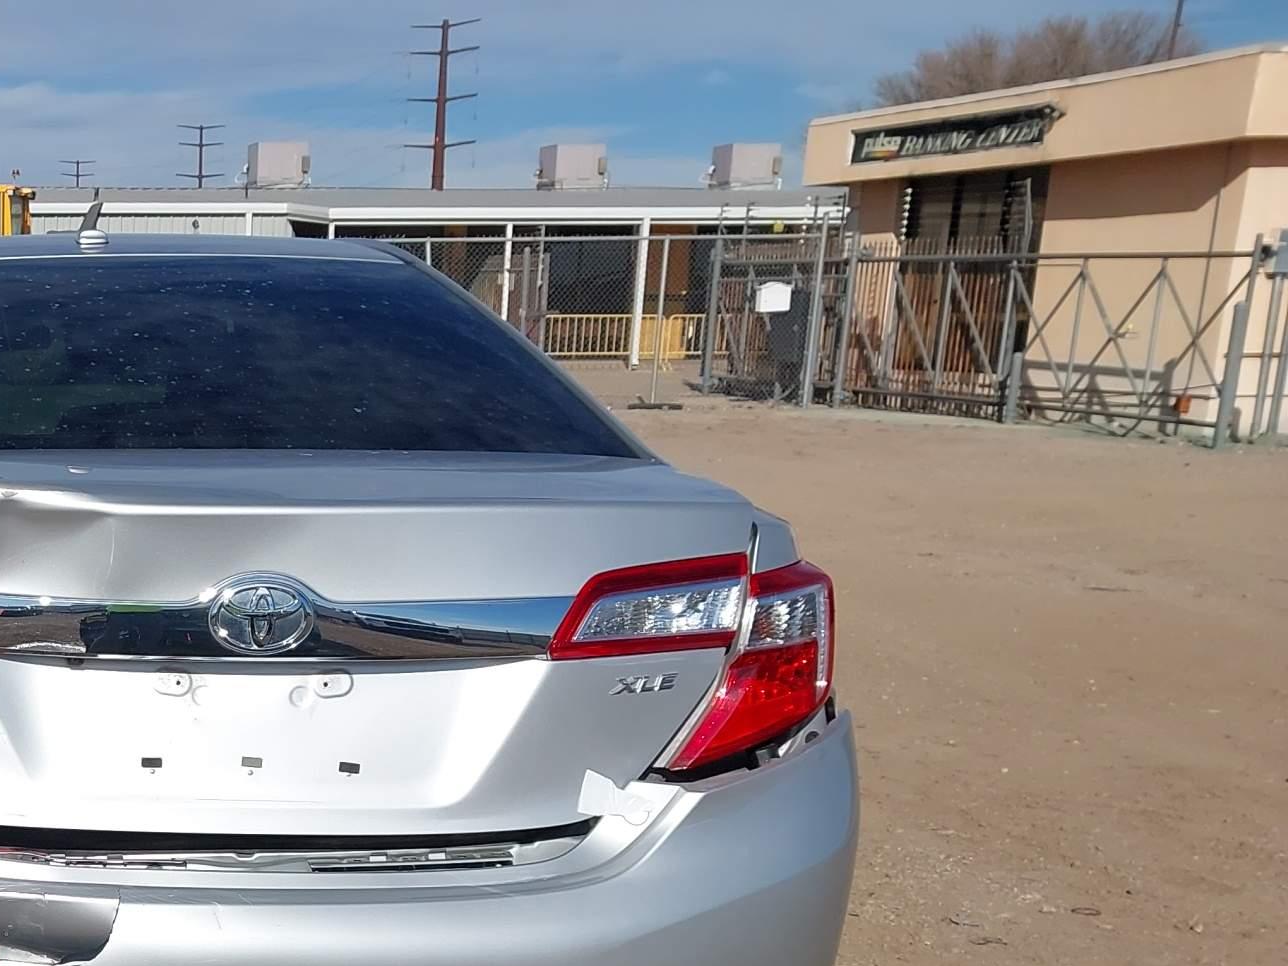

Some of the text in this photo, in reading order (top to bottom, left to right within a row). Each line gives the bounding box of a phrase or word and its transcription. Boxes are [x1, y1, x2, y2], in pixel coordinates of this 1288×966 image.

[862, 120, 1043, 158] pulse BANKING CENTER
[608, 672, 679, 696] XLE
